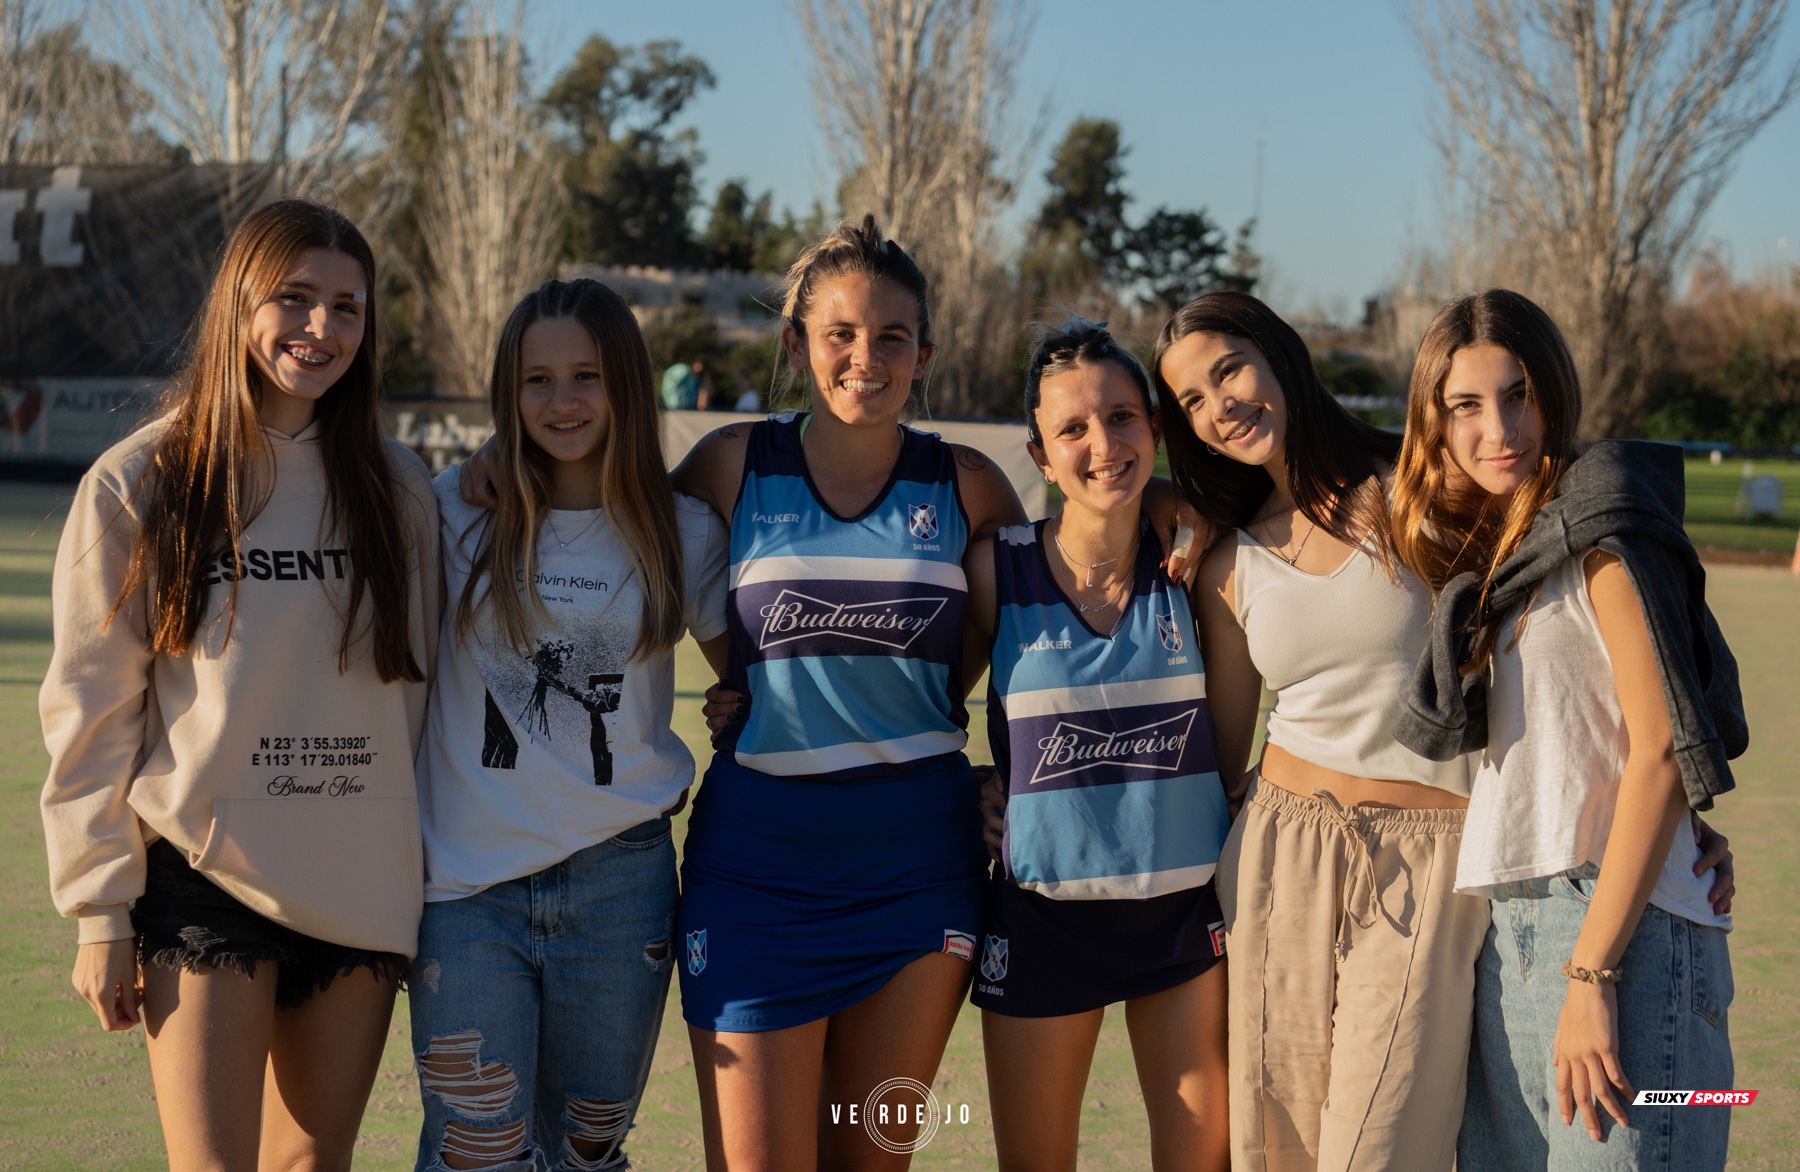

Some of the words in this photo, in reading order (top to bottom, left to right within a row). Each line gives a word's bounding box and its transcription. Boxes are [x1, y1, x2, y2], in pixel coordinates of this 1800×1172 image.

[515, 569, 566, 587] Calvin
[569, 576, 609, 592] Klein
[541, 594, 557, 602] New
[559, 596, 574, 604] York
[759, 602, 931, 633] Budweiser
[1018, 639, 1073, 653] WALKER
[260, 737, 269, 750] N
[1038, 731, 1189, 766] Budweiser
[252, 753, 260, 766] E
[267, 775, 326, 796] Brand
[328, 775, 366, 797] New
[978, 983, 986, 993] 50
[986, 985, 1004, 996] AÑOS
